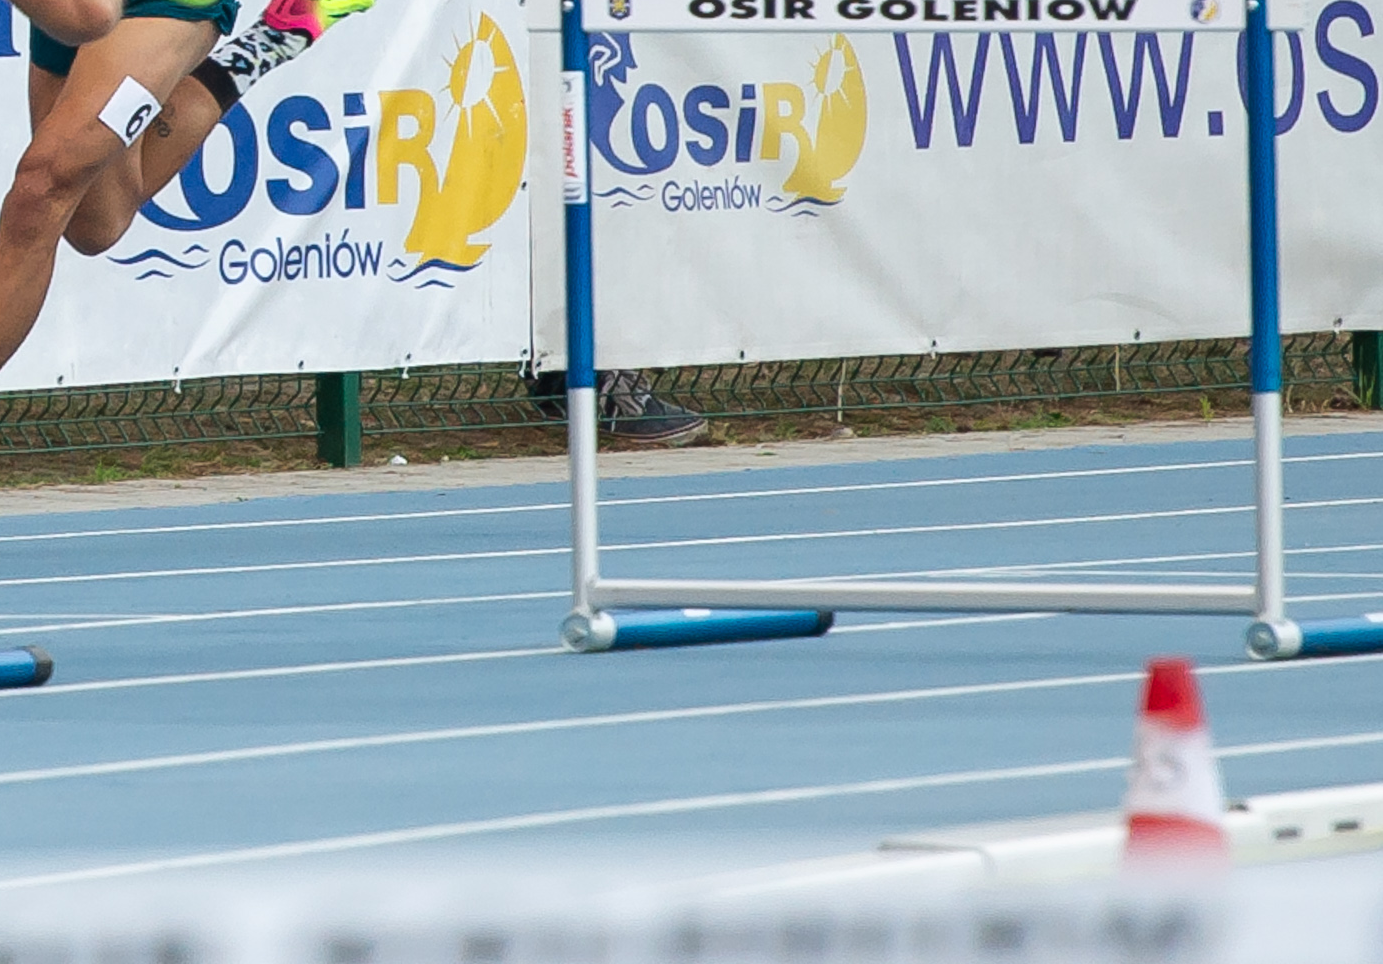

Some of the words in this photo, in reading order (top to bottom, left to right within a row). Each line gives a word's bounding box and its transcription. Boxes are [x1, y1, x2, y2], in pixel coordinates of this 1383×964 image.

[125, 103, 152, 140] 6
[662, 175, 762, 212] Goleniów
[218, 228, 384, 285] Goleniów
